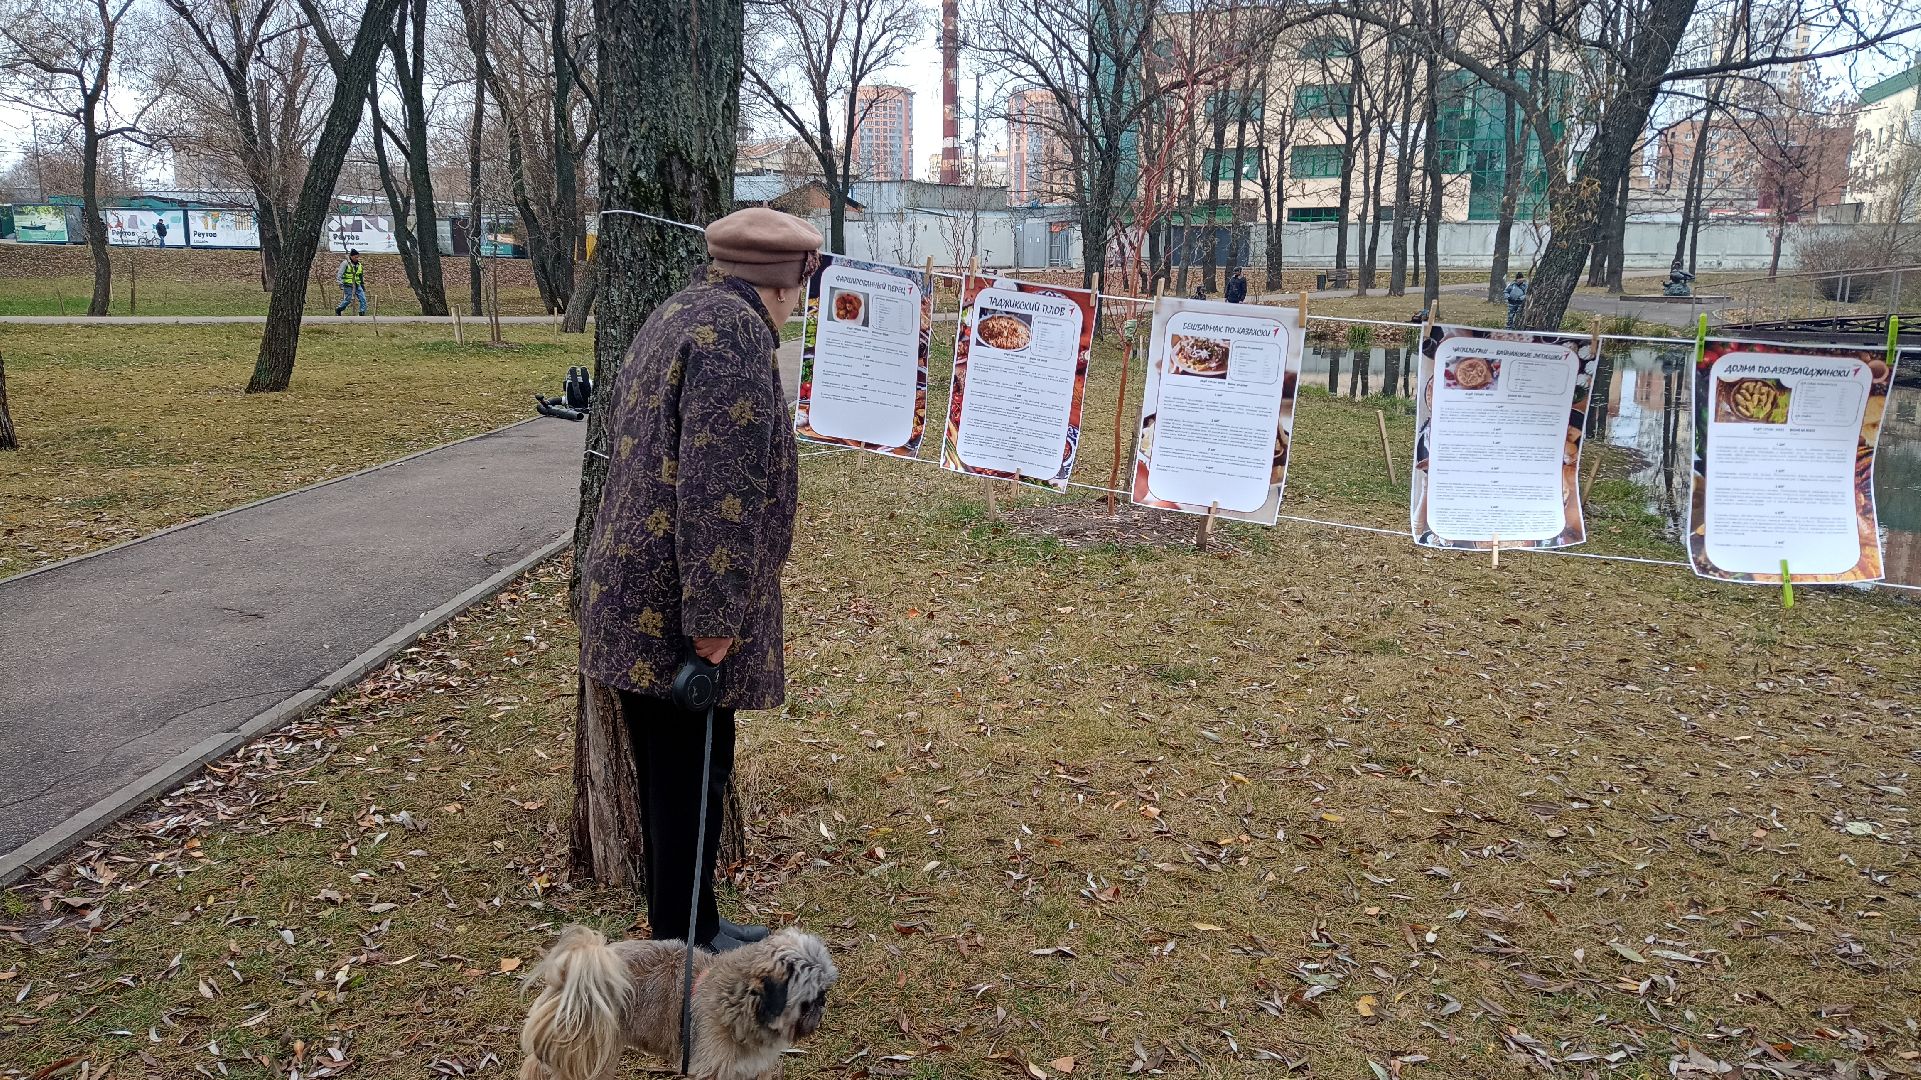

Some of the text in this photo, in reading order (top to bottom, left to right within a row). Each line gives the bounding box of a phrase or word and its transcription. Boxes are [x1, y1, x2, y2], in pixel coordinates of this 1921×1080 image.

[194, 230, 217, 239] Реутов
[835, 275, 906, 296] ФАРШИРОВАННЫЙ ПЕРЕЦ
[988, 296, 1066, 316] ТАДЖИКСКИЙ ПЛОВ
[1183, 322, 1271, 337] БЕШБАРМАК ПО-КАЗАХСКИ
[1724, 364, 1850, 378] ДОЛМА ПО-АЗЕРБАЙДЖАНСКИ
